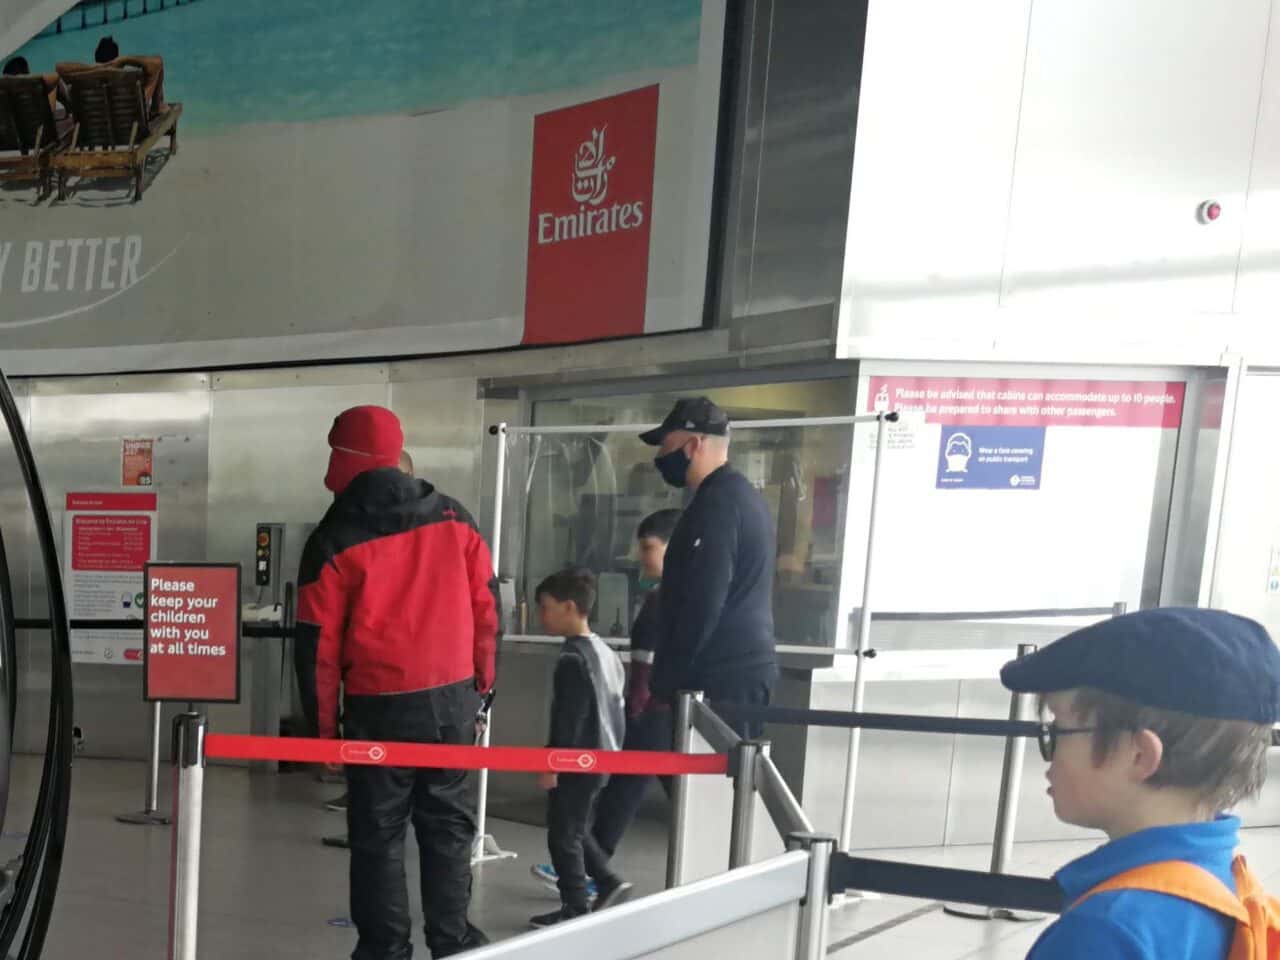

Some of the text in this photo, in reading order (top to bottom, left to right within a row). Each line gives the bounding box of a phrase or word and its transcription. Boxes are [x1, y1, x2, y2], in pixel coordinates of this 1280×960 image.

[537, 201, 644, 244] Emirates
[21, 235, 142, 293] BETTER
[895, 388, 925, 399] Please
[927, 388, 938, 399] be
[940, 388, 974, 400] advised
[976, 389, 995, 400] that
[1027, 392, 1043, 401] can
[1109, 393, 1120, 405] up
[1121, 393, 1132, 403] to
[894, 402, 924, 414] Please
[926, 403, 938, 414] be
[939, 404, 979, 416] prepared
[981, 404, 991, 415] to
[993, 404, 1017, 415] share
[1019, 404, 1039, 416] with
[1041, 405, 1065, 417] other
[150, 578, 195, 592] Please
[150, 594, 218, 612] keep your
[150, 610, 205, 624] children
[150, 626, 180, 640] with
[184, 628, 209, 642] you
[150, 642, 226, 656] at all times
